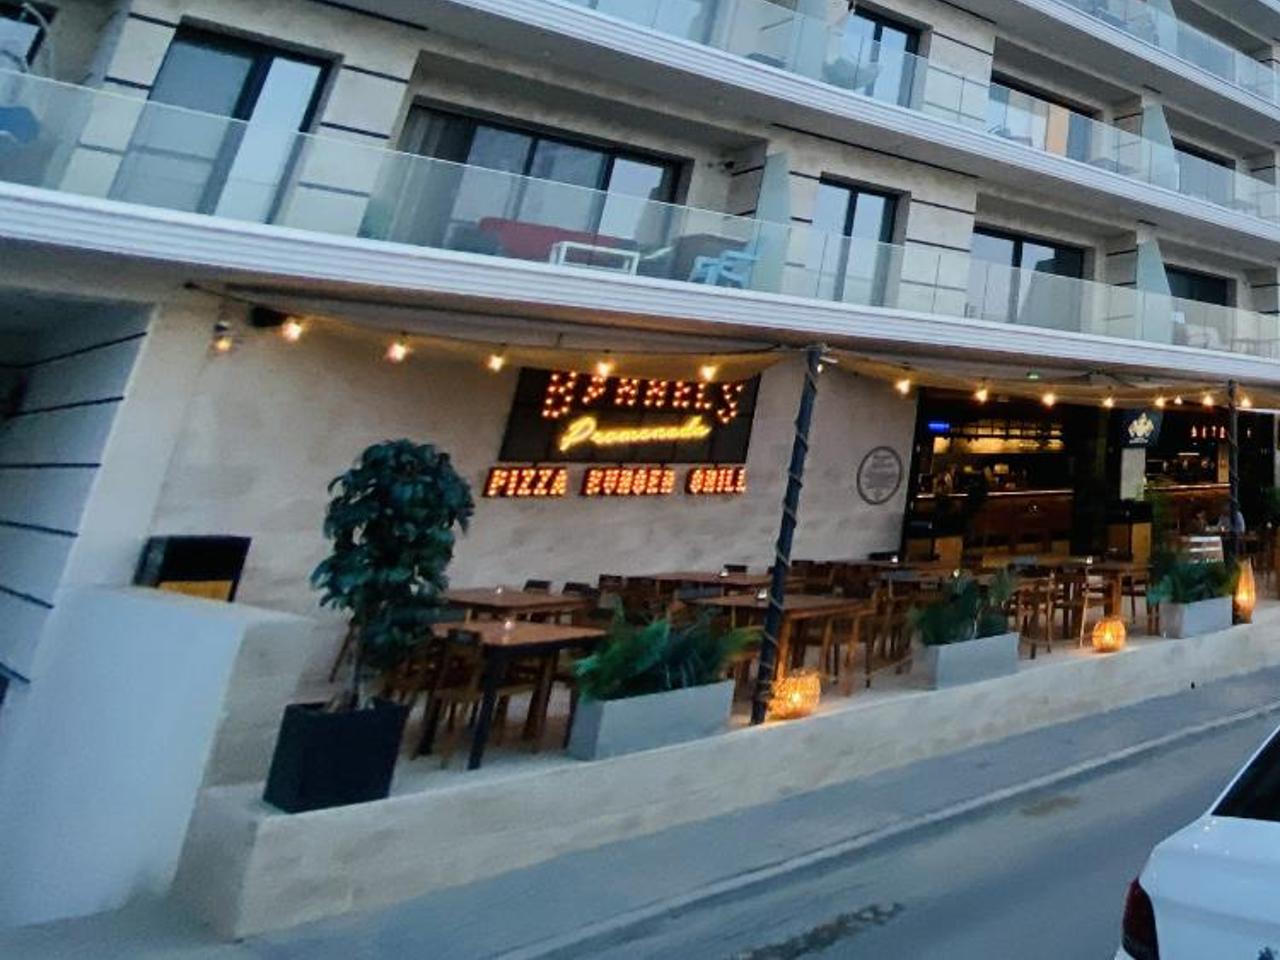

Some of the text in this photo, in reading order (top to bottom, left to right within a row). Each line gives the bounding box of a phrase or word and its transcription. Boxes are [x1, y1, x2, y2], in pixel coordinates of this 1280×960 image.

[485, 467, 747, 496] PIZZA BURGER GRILL
